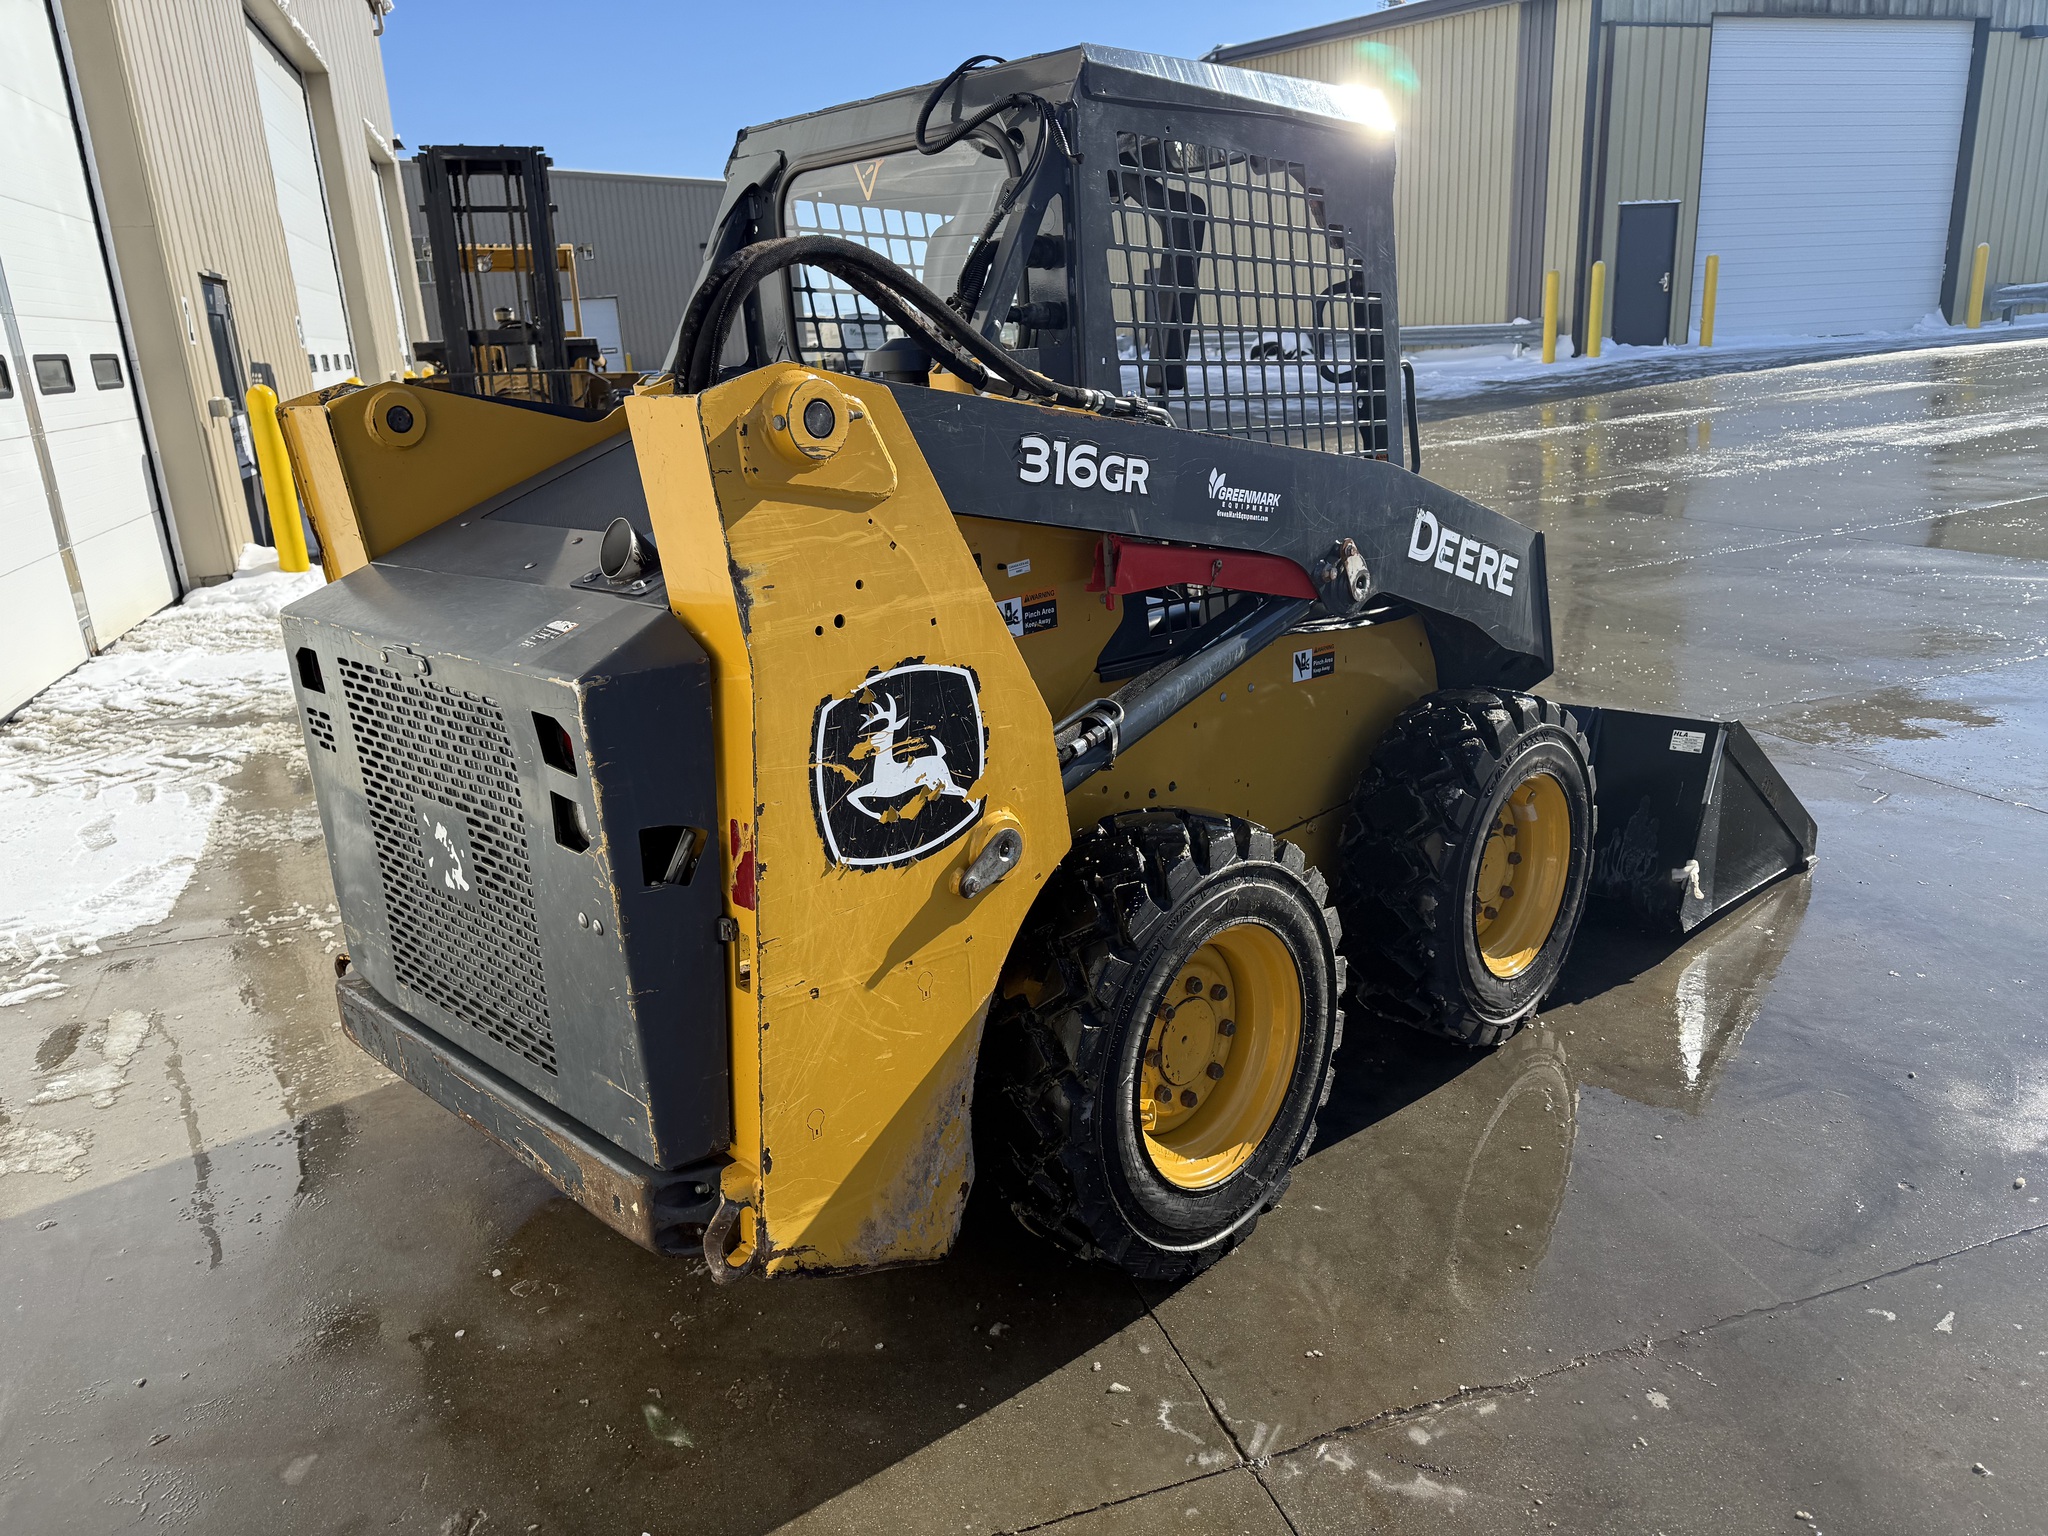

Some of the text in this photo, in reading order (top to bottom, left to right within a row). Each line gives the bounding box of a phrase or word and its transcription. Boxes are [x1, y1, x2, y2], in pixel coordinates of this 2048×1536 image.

[1020, 437, 1149, 495] 316GR
[1218, 486, 1281, 507] GREENMARK
[1222, 501, 1275, 513] EQUIPMENT
[1407, 508, 1519, 597] DEERE
[1029, 590, 1055, 601] WARNING
[1024, 606, 1055, 620] Pinch Area
